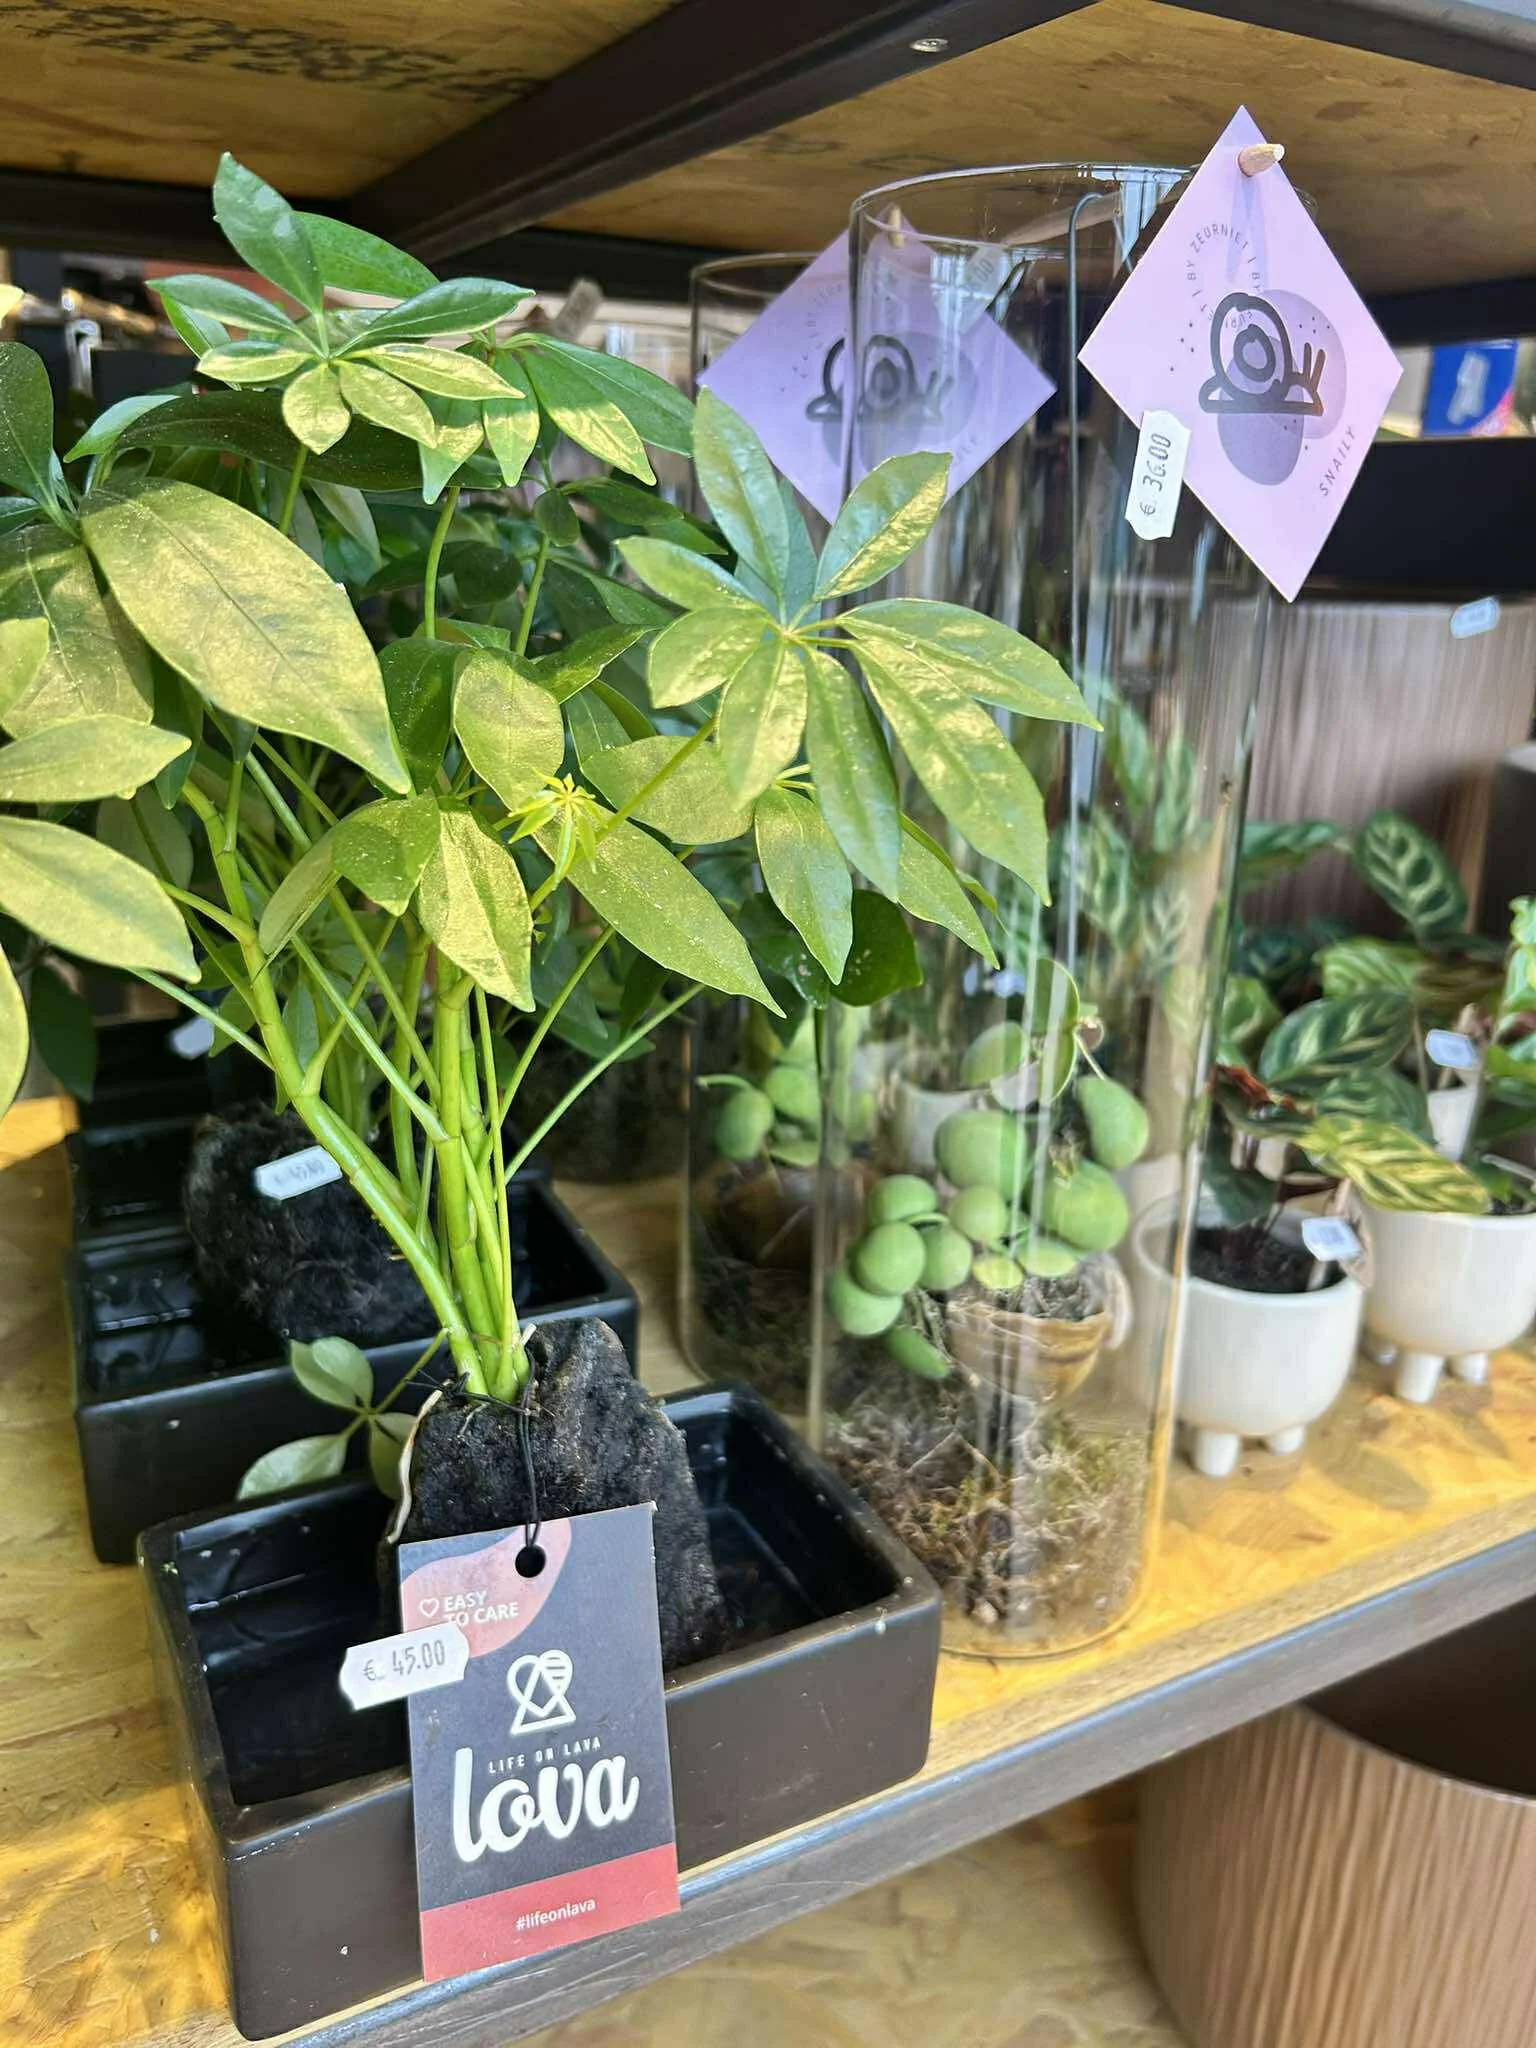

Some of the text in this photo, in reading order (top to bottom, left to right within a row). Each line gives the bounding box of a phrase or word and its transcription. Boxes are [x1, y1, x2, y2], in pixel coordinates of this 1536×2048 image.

[1142, 433, 1172, 492] 36.00
[1319, 425, 1355, 497] SNAILY
[443, 1590, 487, 1613] EASY
[473, 1602, 519, 1624] CARE
[392, 1640, 446, 1676] 45.00
[488, 1754, 526, 1774] LIFE
[563, 1736, 602, 1757] LAVA
[453, 1747, 641, 1863] lova
[516, 1899, 596, 1931] #lifeonlava
